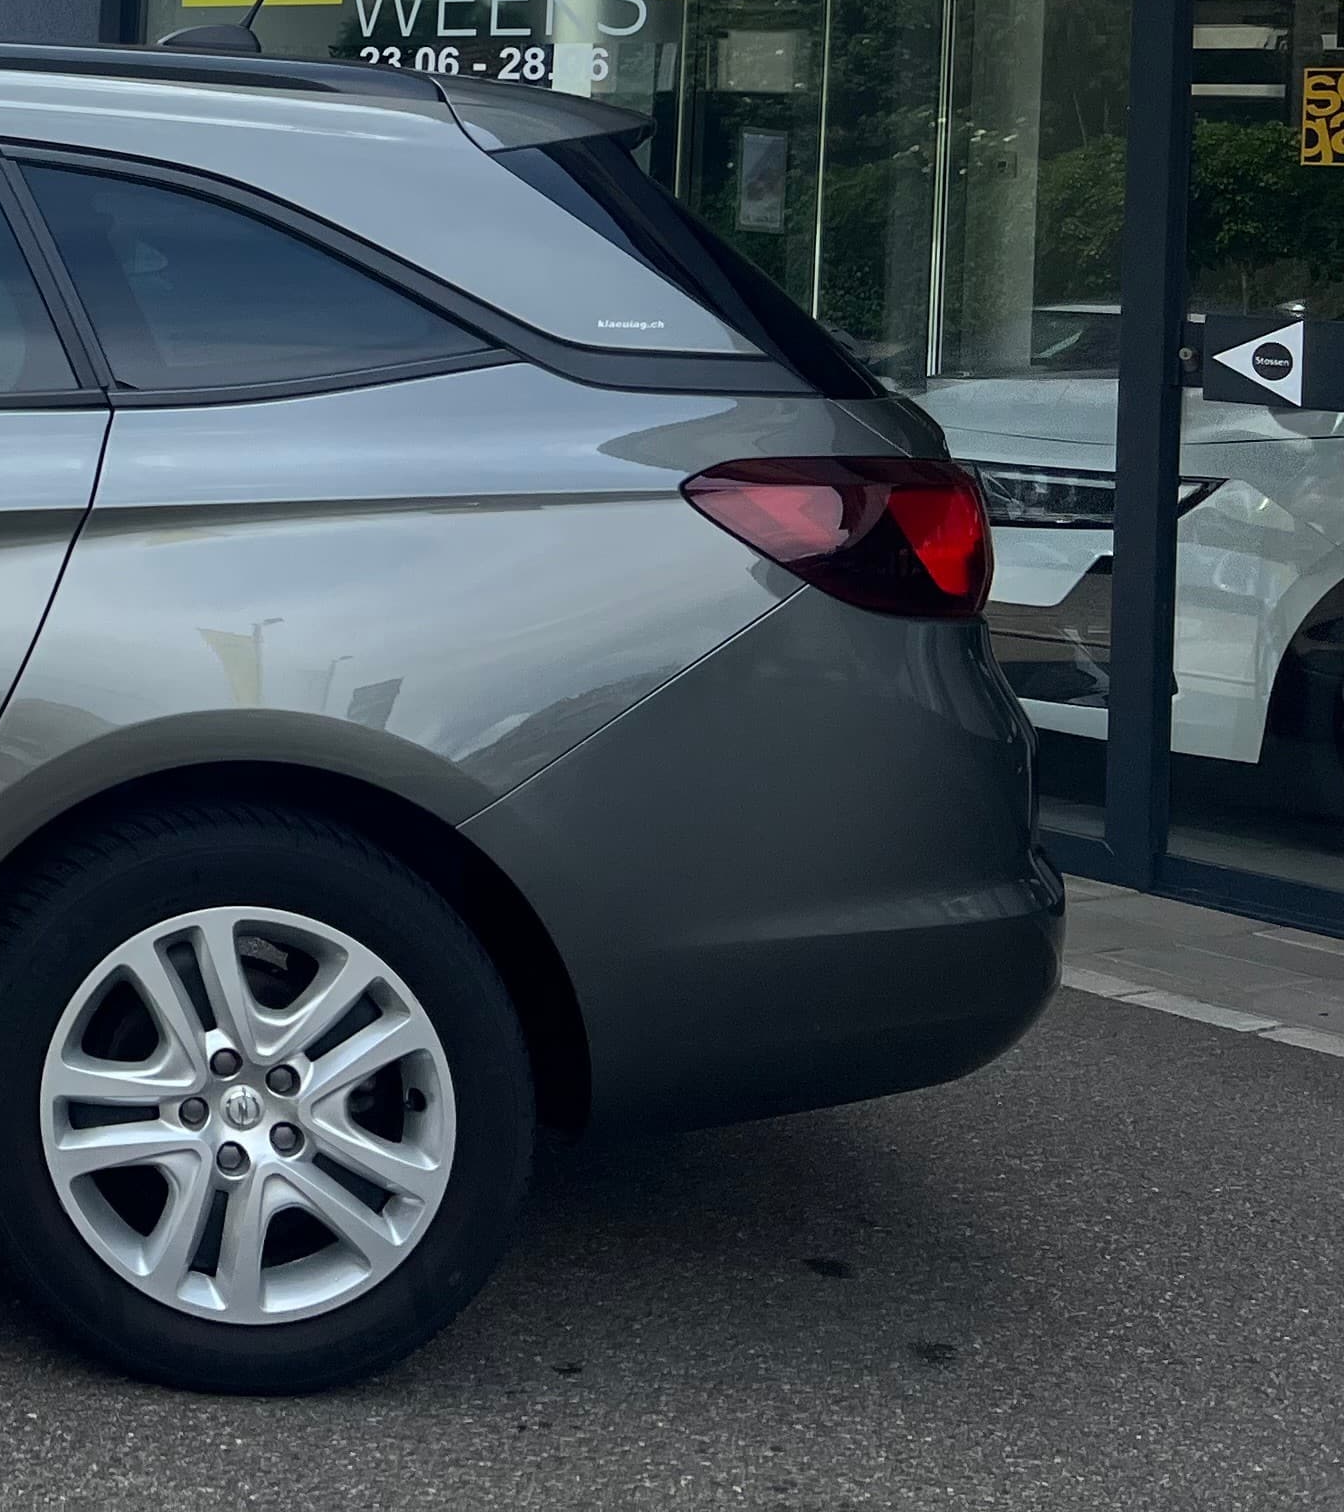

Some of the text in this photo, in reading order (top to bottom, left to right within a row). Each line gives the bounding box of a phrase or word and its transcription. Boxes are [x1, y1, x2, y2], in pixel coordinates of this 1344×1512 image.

[359, 46, 460, 76] 2306
[497, 46, 609, 82] 28.6
[1255, 356, 1290, 367] Stossen
